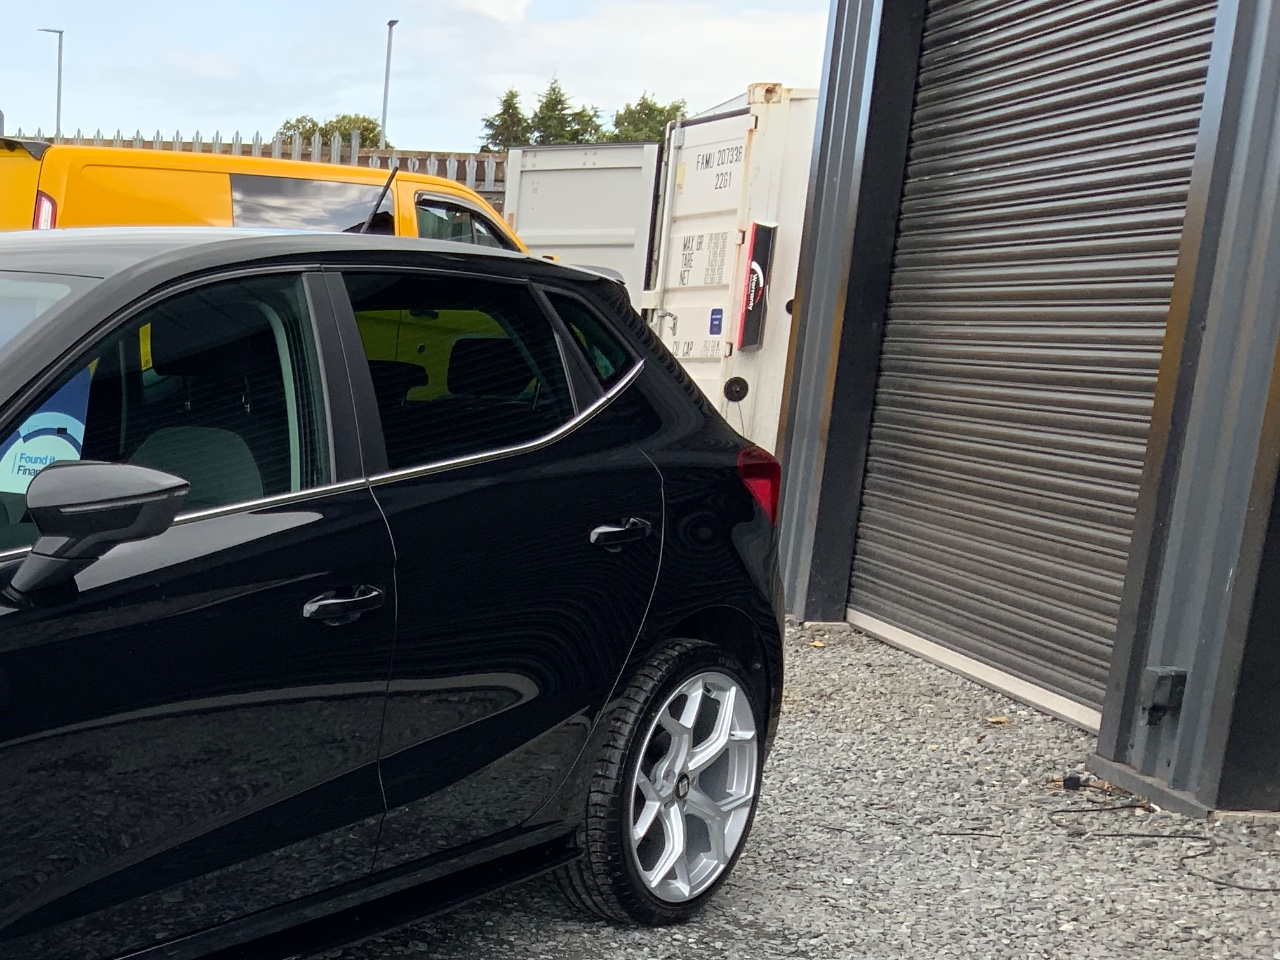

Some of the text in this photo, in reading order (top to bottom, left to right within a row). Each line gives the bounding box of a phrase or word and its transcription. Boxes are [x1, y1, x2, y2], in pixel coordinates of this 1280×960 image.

[696, 152, 715, 171] FAMU
[714, 171, 732, 190] 22G1
[678, 269, 690, 286] NET
[747, 273, 758, 311] Warranty
[20, 452, 48, 465] Found
